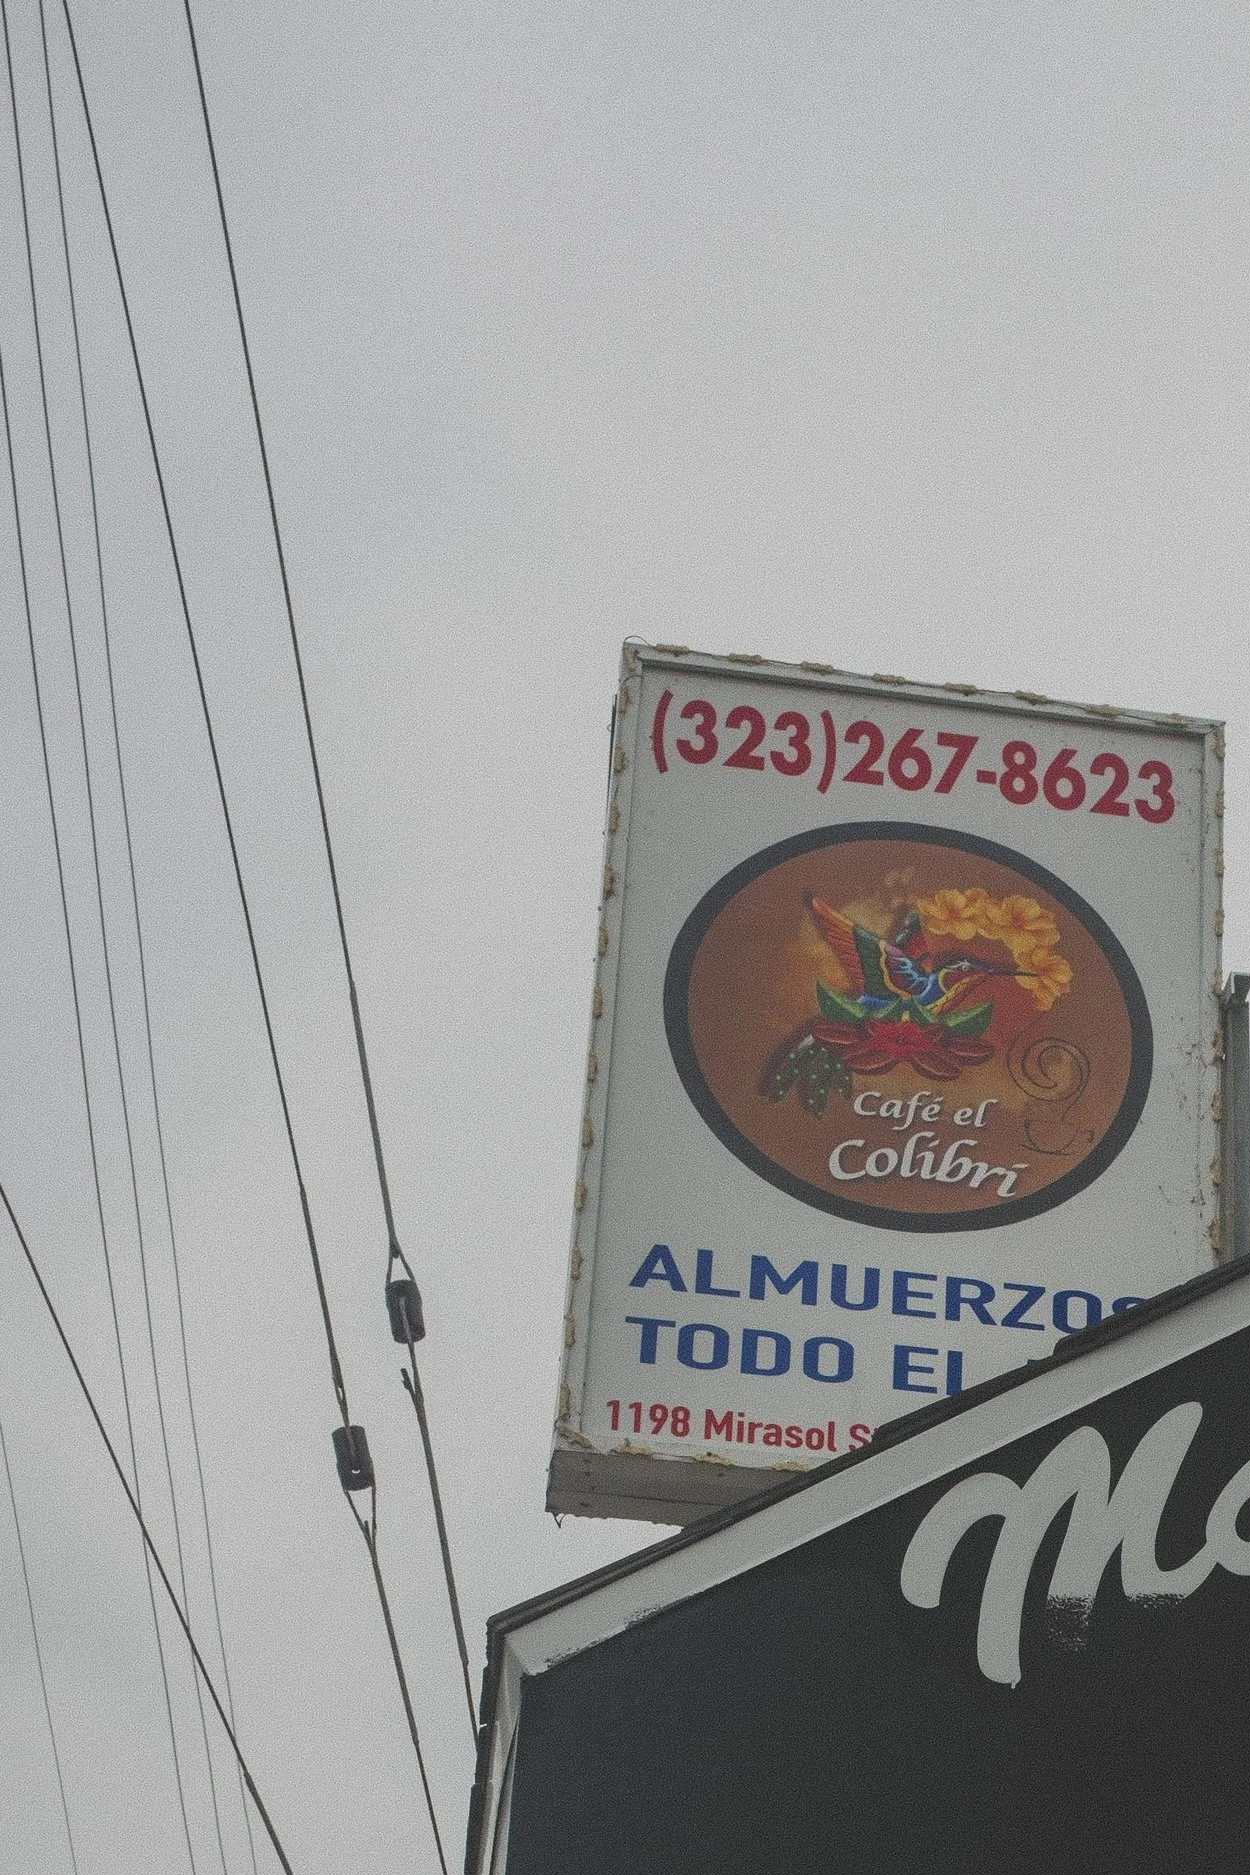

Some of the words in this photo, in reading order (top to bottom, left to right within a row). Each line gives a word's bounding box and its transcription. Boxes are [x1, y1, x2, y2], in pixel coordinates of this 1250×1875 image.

[653, 690, 1175, 824] (323)267-8623
[853, 1091, 944, 1130] Café
[953, 1099, 998, 1127] el
[625, 1316, 854, 1383] TODO
[606, 1400, 690, 1439] 1198
[704, 1408, 835, 1451] Mirasol
[849, 1422, 879, 1454] S
